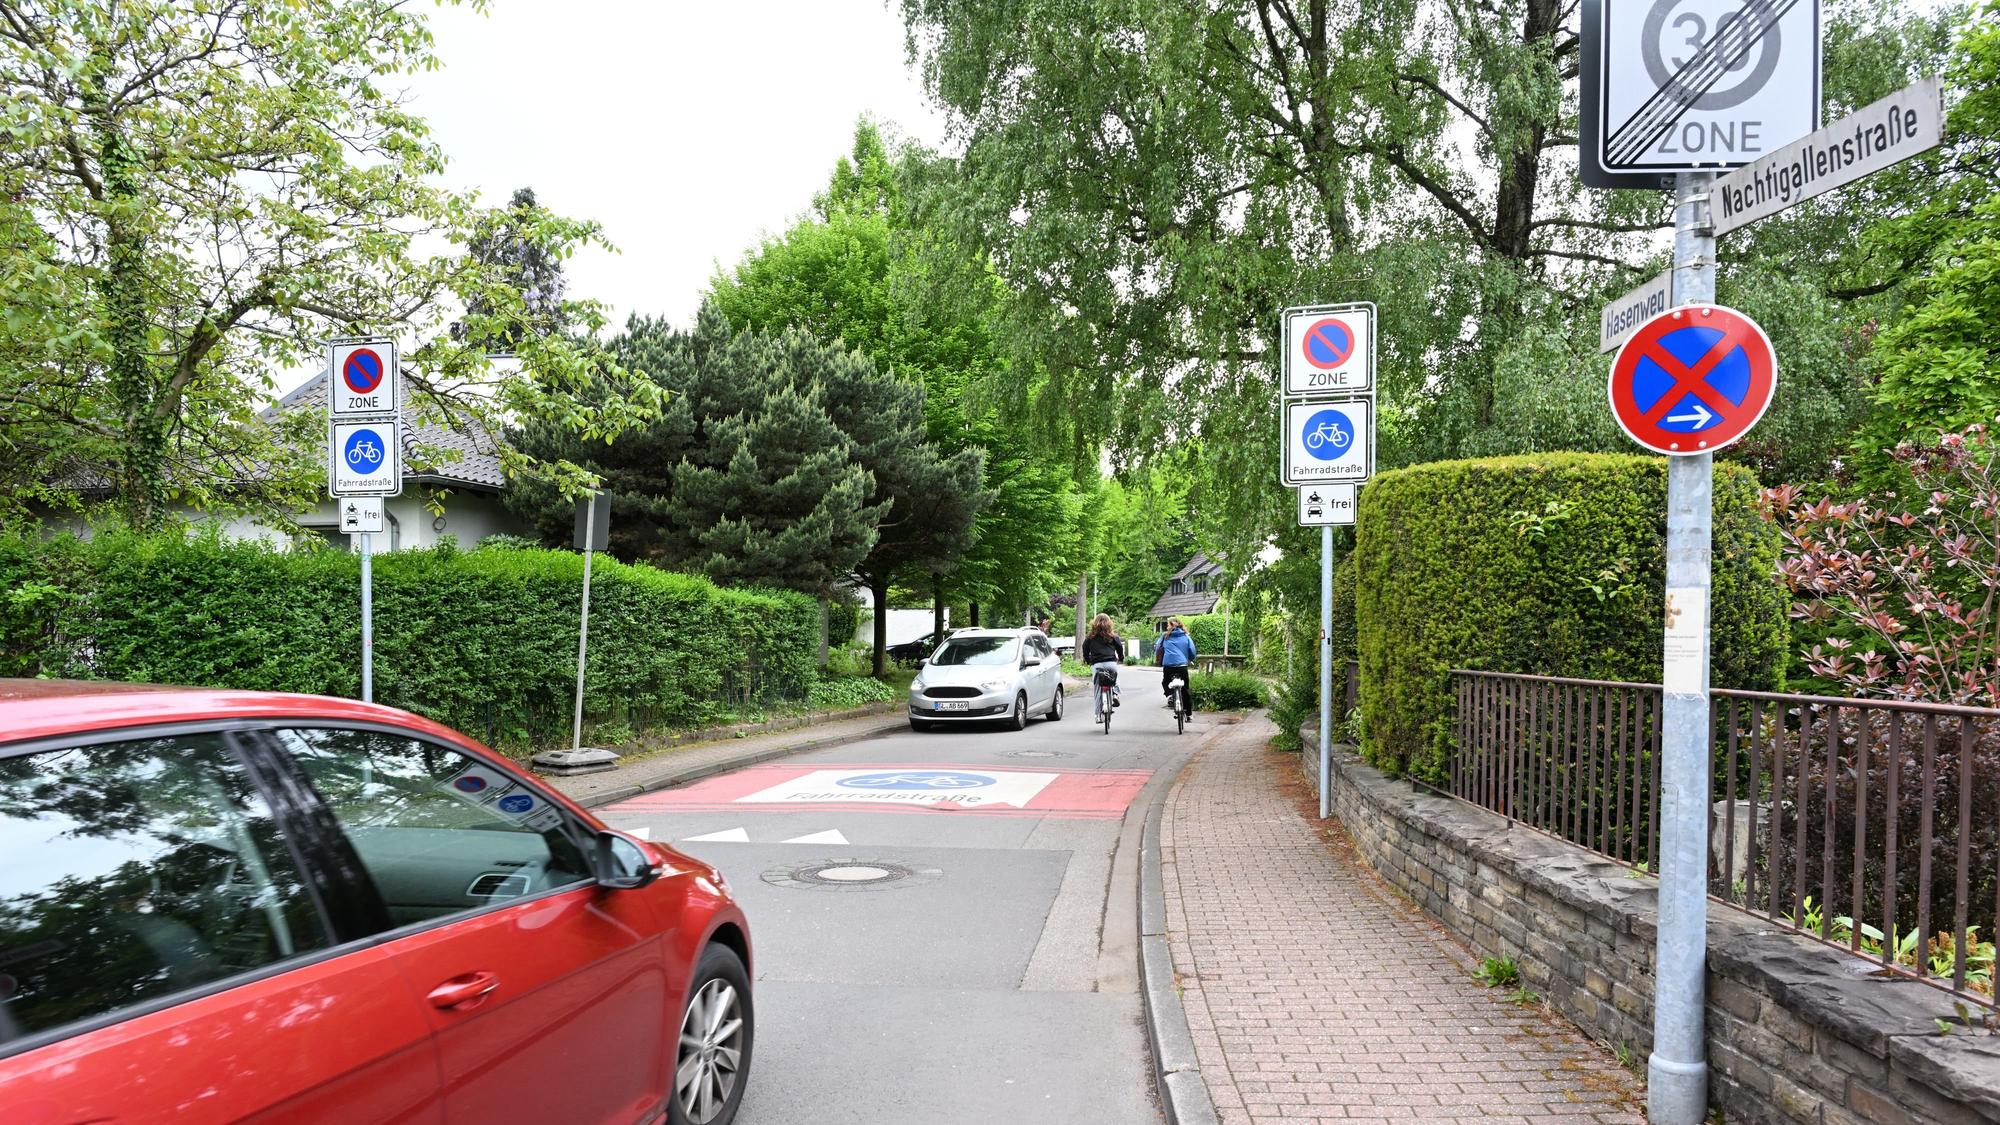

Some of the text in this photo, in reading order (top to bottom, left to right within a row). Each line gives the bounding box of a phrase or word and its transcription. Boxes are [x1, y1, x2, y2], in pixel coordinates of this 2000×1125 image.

[1671, 12, 1751, 72] 30
[1658, 121, 1762, 153] ZONE
[1722, 104, 1918, 219] Nachtigallenstraße
[1606, 288, 1665, 340] Hasenweg
[1308, 372, 1348, 386] ZONE
[348, 396, 379, 409] ZONE
[1293, 464, 1362, 475] Fahrradstraße
[338, 477, 392, 488] Fahrradstraße
[1331, 498, 1352, 509] frei
[364, 509, 380, 520] frei
[786, 792, 982, 804] Fahrradstraße
